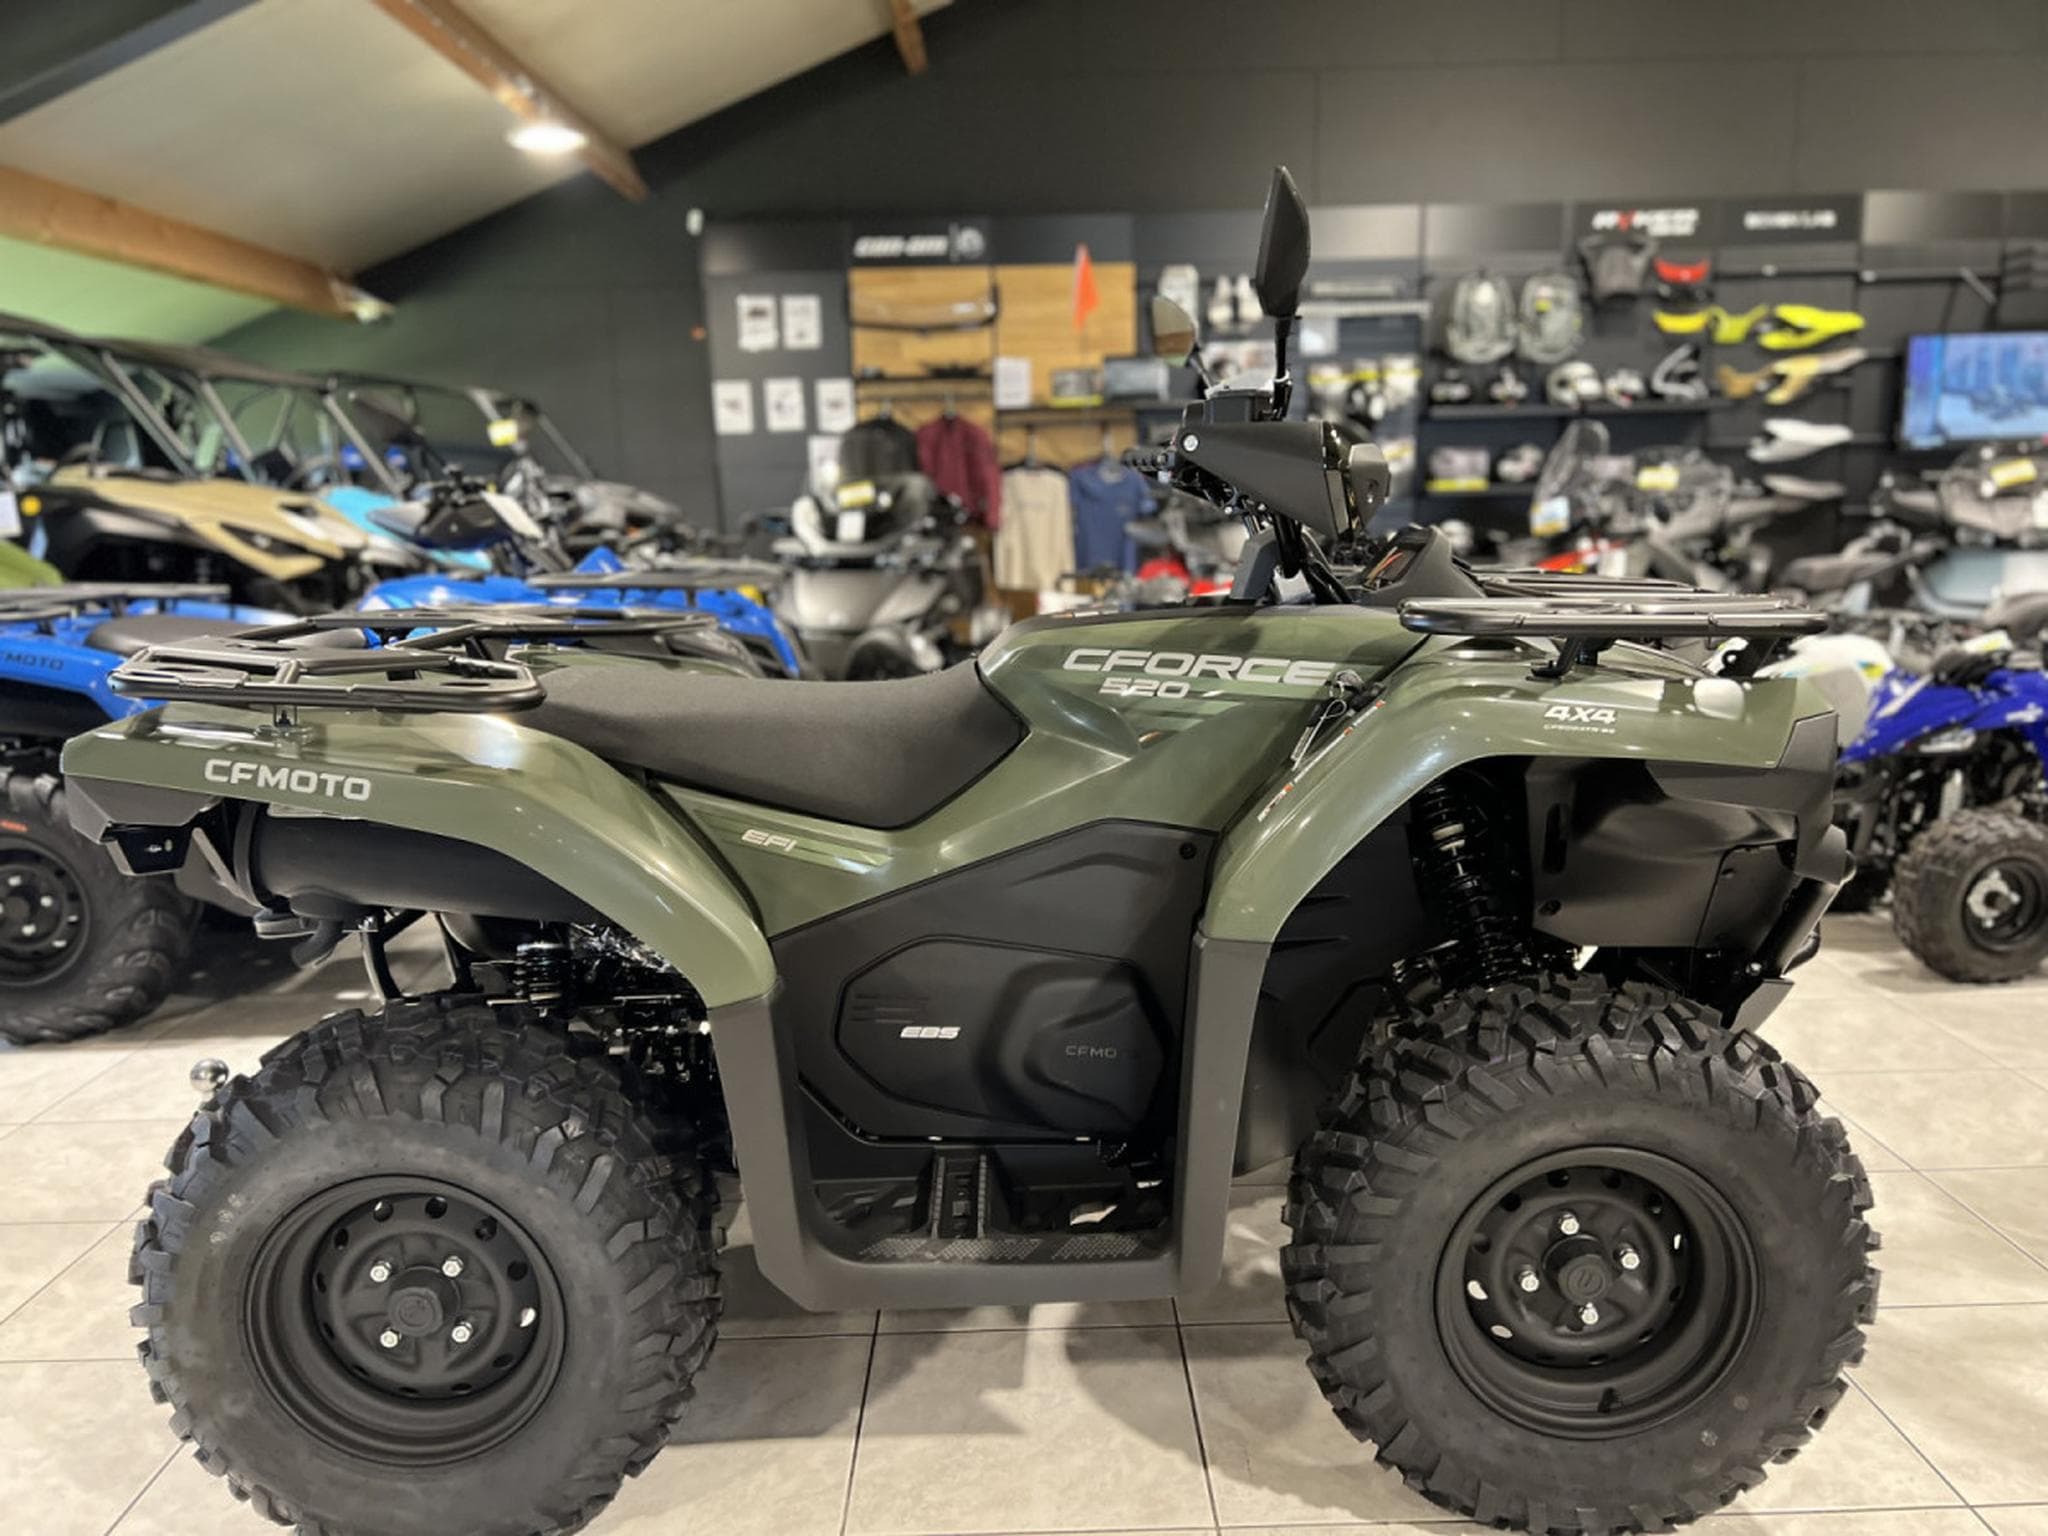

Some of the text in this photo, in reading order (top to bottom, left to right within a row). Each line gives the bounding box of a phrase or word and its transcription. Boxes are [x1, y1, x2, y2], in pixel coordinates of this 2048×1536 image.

[0, 650, 65, 671] MOTO
[1062, 647, 1337, 687] CFORCE
[1099, 676, 1191, 699] 520
[204, 758, 372, 801] CFMOTO
[741, 828, 798, 852] EFI
[1065, 1044, 1128, 1060] CFMO
